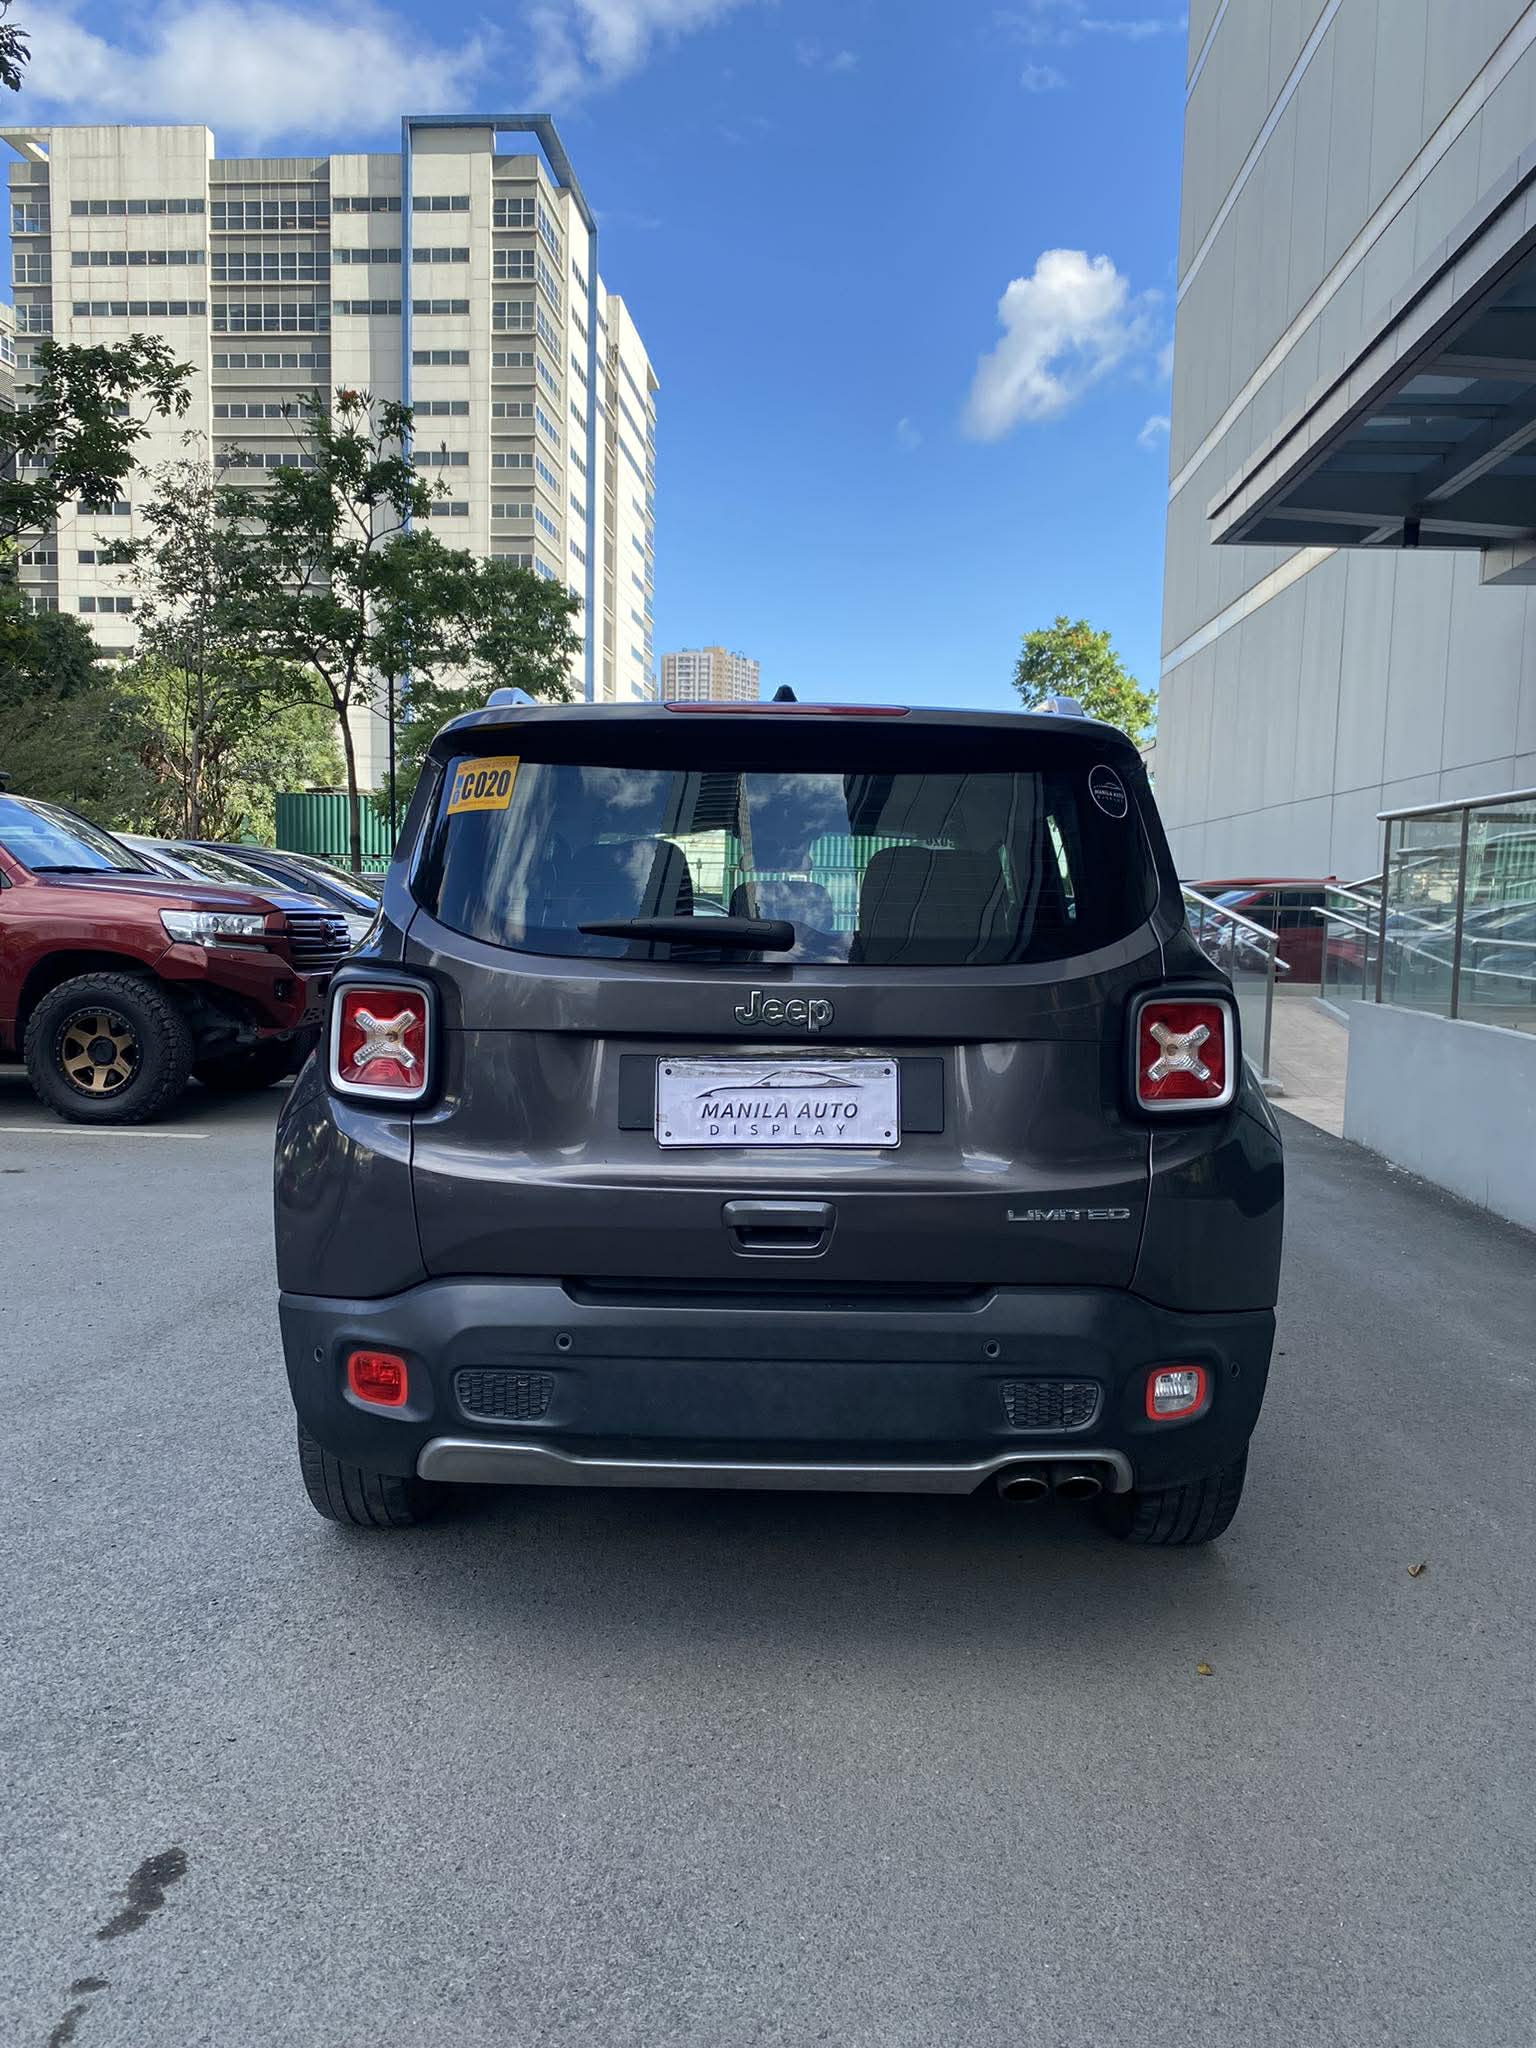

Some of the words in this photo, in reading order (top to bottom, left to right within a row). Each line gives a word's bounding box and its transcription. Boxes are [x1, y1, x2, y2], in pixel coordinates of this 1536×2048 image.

[735, 990, 834, 1032] Jeep
[701, 1102, 788, 1119] MANILA
[797, 1102, 859, 1119] AUTO
[709, 1124, 849, 1136] DISPLAY
[1007, 1208, 1130, 1221] LIMITED
